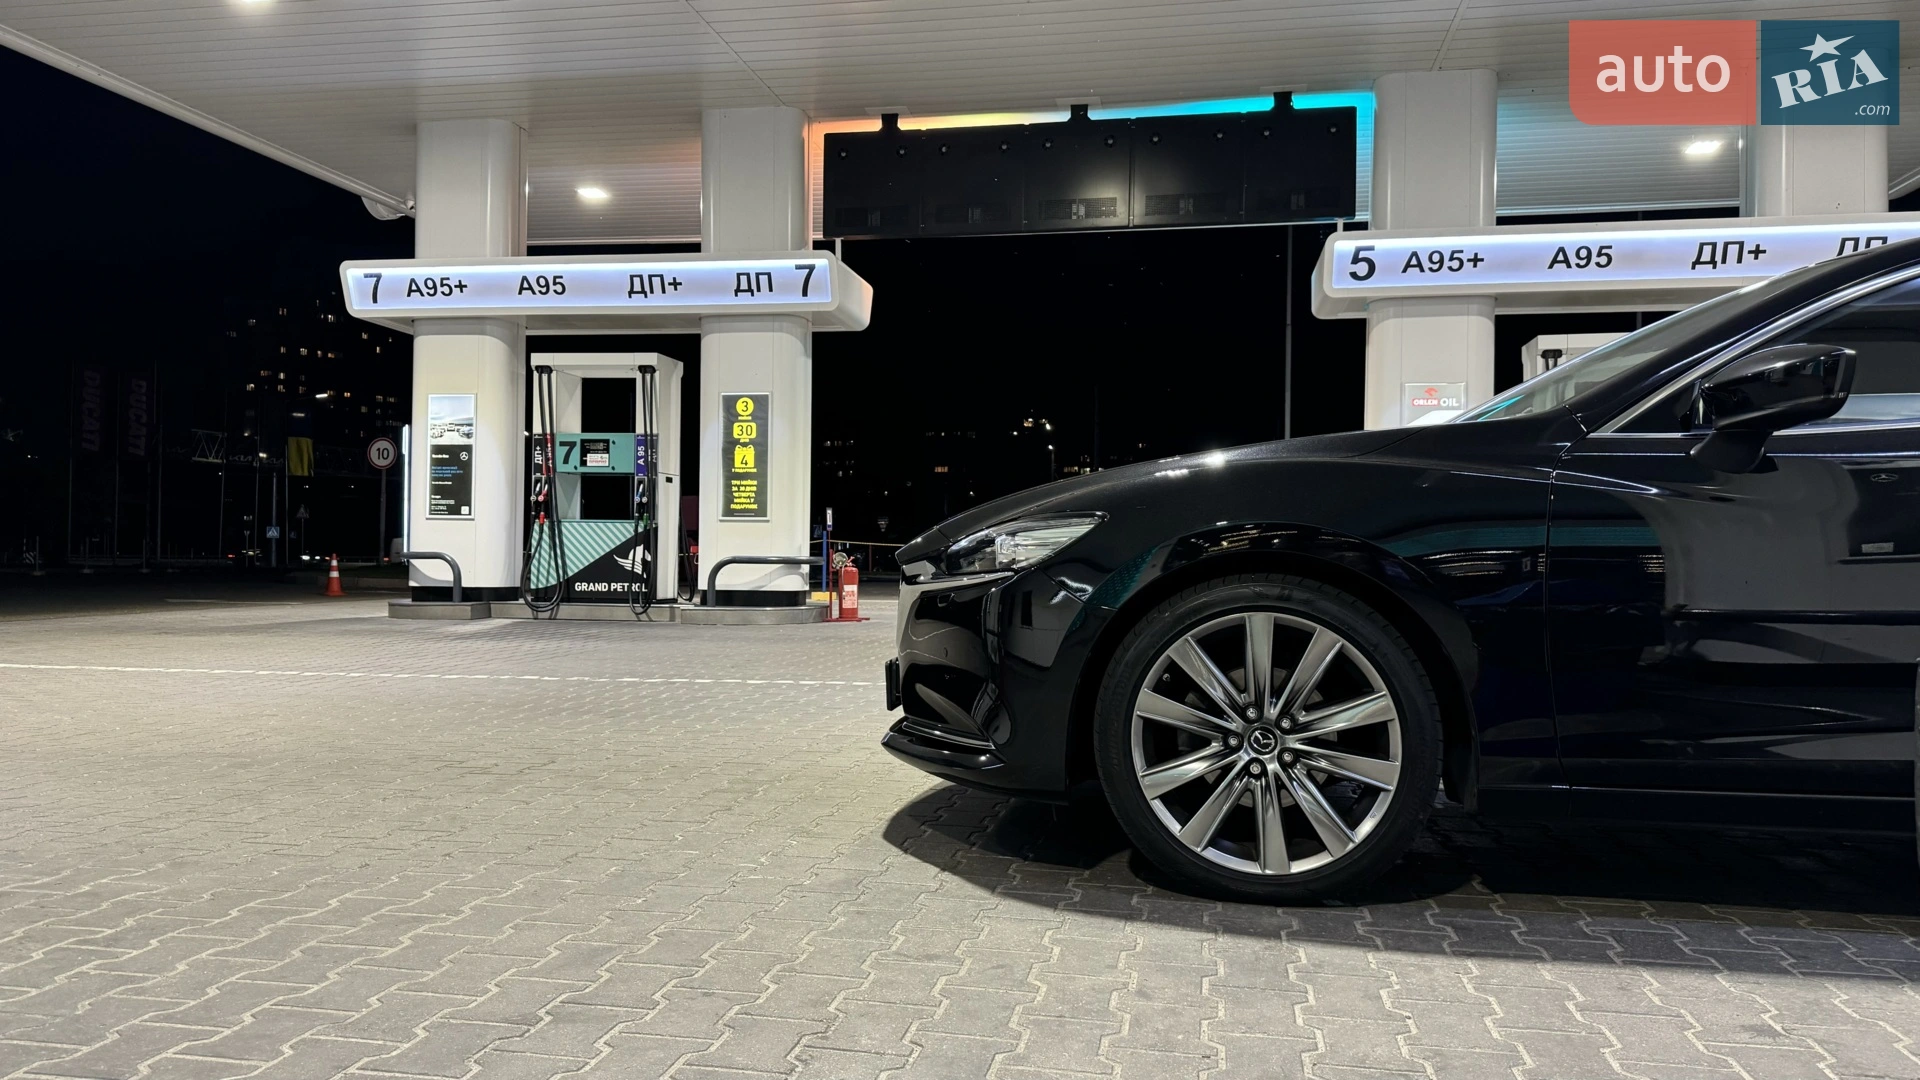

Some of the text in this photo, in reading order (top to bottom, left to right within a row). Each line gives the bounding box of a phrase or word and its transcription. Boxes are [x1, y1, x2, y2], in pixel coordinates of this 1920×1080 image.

[1348, 247, 1376, 282] 5
[1401, 249, 1485, 274] А95+
[1547, 245, 1613, 270] А95
[1690, 240, 1767, 271] ДП+
[364, 264, 816, 304] 7 А95+ А95 ДП+ ДП 7
[80, 368, 101, 452] DUCATI
[741, 400, 749, 413] 3
[1413, 397, 1460, 407] ORLEN OIL
[128, 377, 148, 457] DUCATI
[736, 424, 753, 437] 30
[375, 447, 390, 461] 10
[534, 445, 543, 465] ДП+
[559, 441, 577, 465] 7
[637, 445, 645, 466] А 95
[740, 454, 749, 467] 4
[574, 582, 609, 592] GRAND
